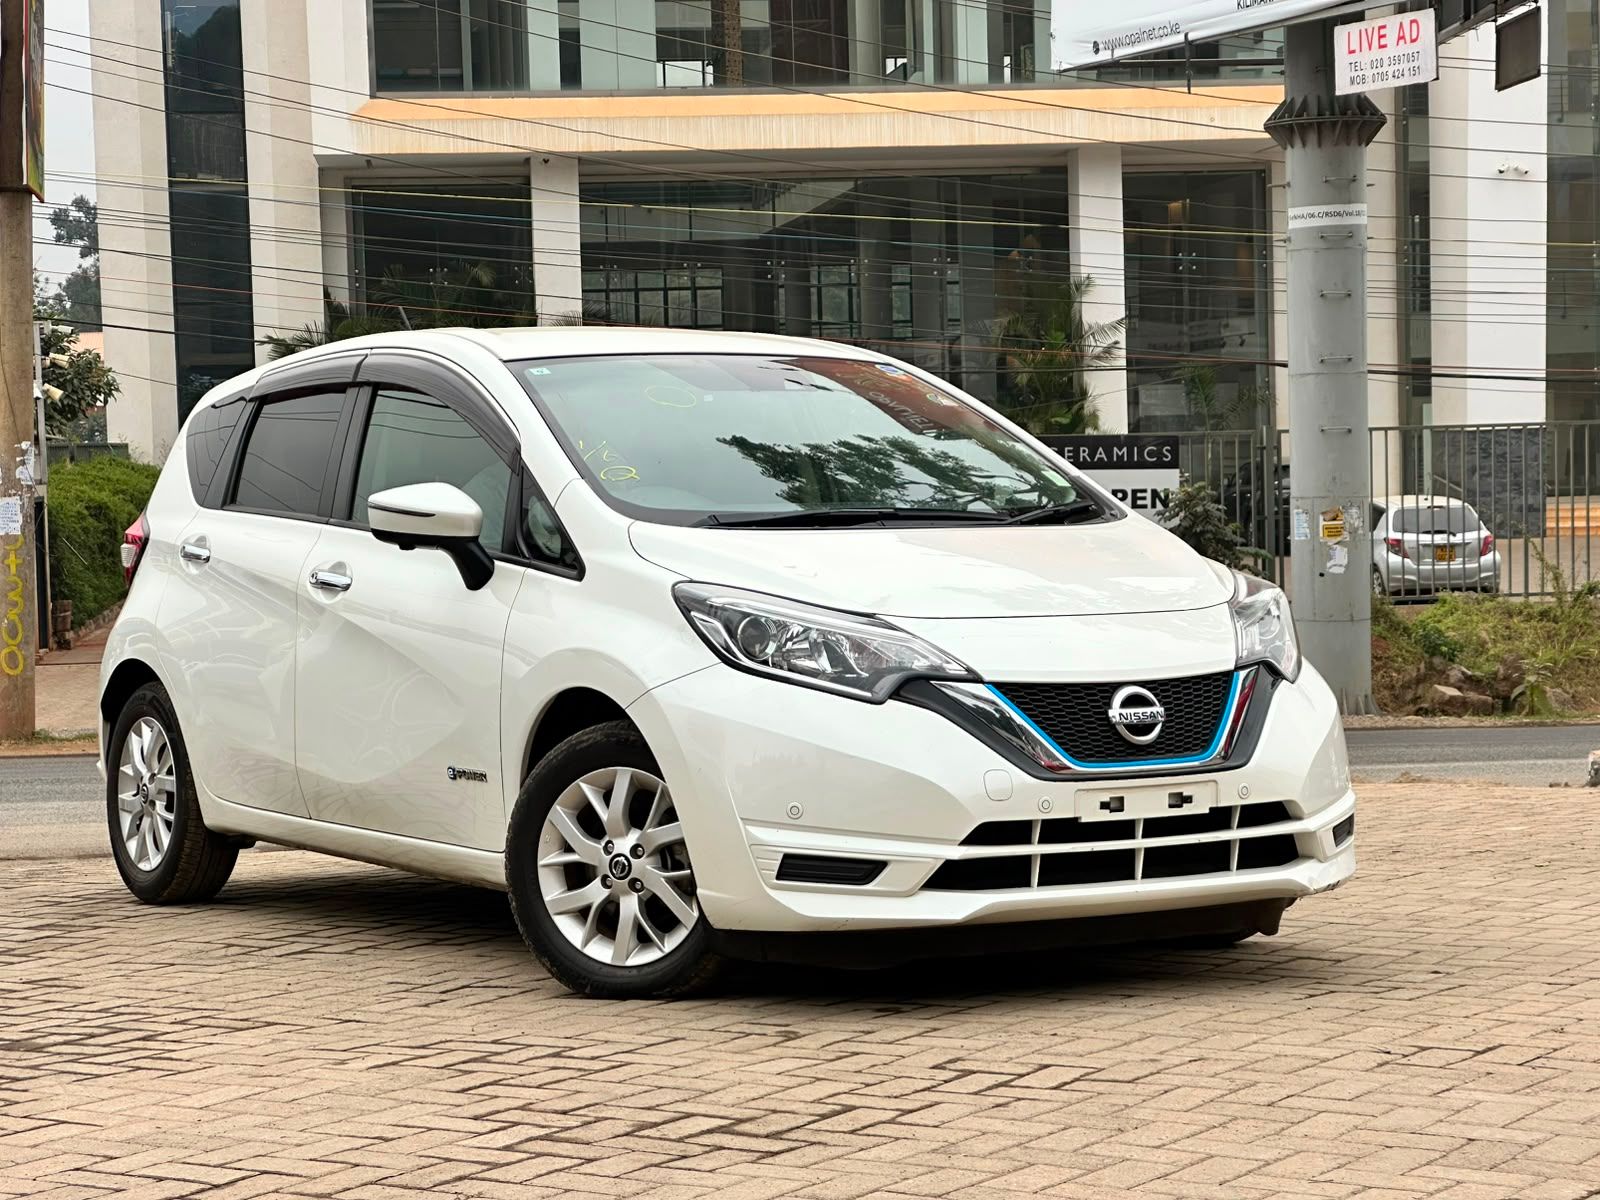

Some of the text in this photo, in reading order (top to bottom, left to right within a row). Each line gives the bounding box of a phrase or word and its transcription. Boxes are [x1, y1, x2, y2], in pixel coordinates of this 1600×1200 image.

[1102, 20, 1181, 51] www.opalnet.co.ke
[1347, 18, 1420, 55] LIVE AD
[1349, 51, 1420, 73] TEL: 020 3597057
[1350, 65, 1421, 87] MOB: 0705 424 151
[1050, 446, 1172, 462] ERAMICS
[1111, 488, 1170, 510] PEN
[1118, 710, 1163, 721] NISSAN
